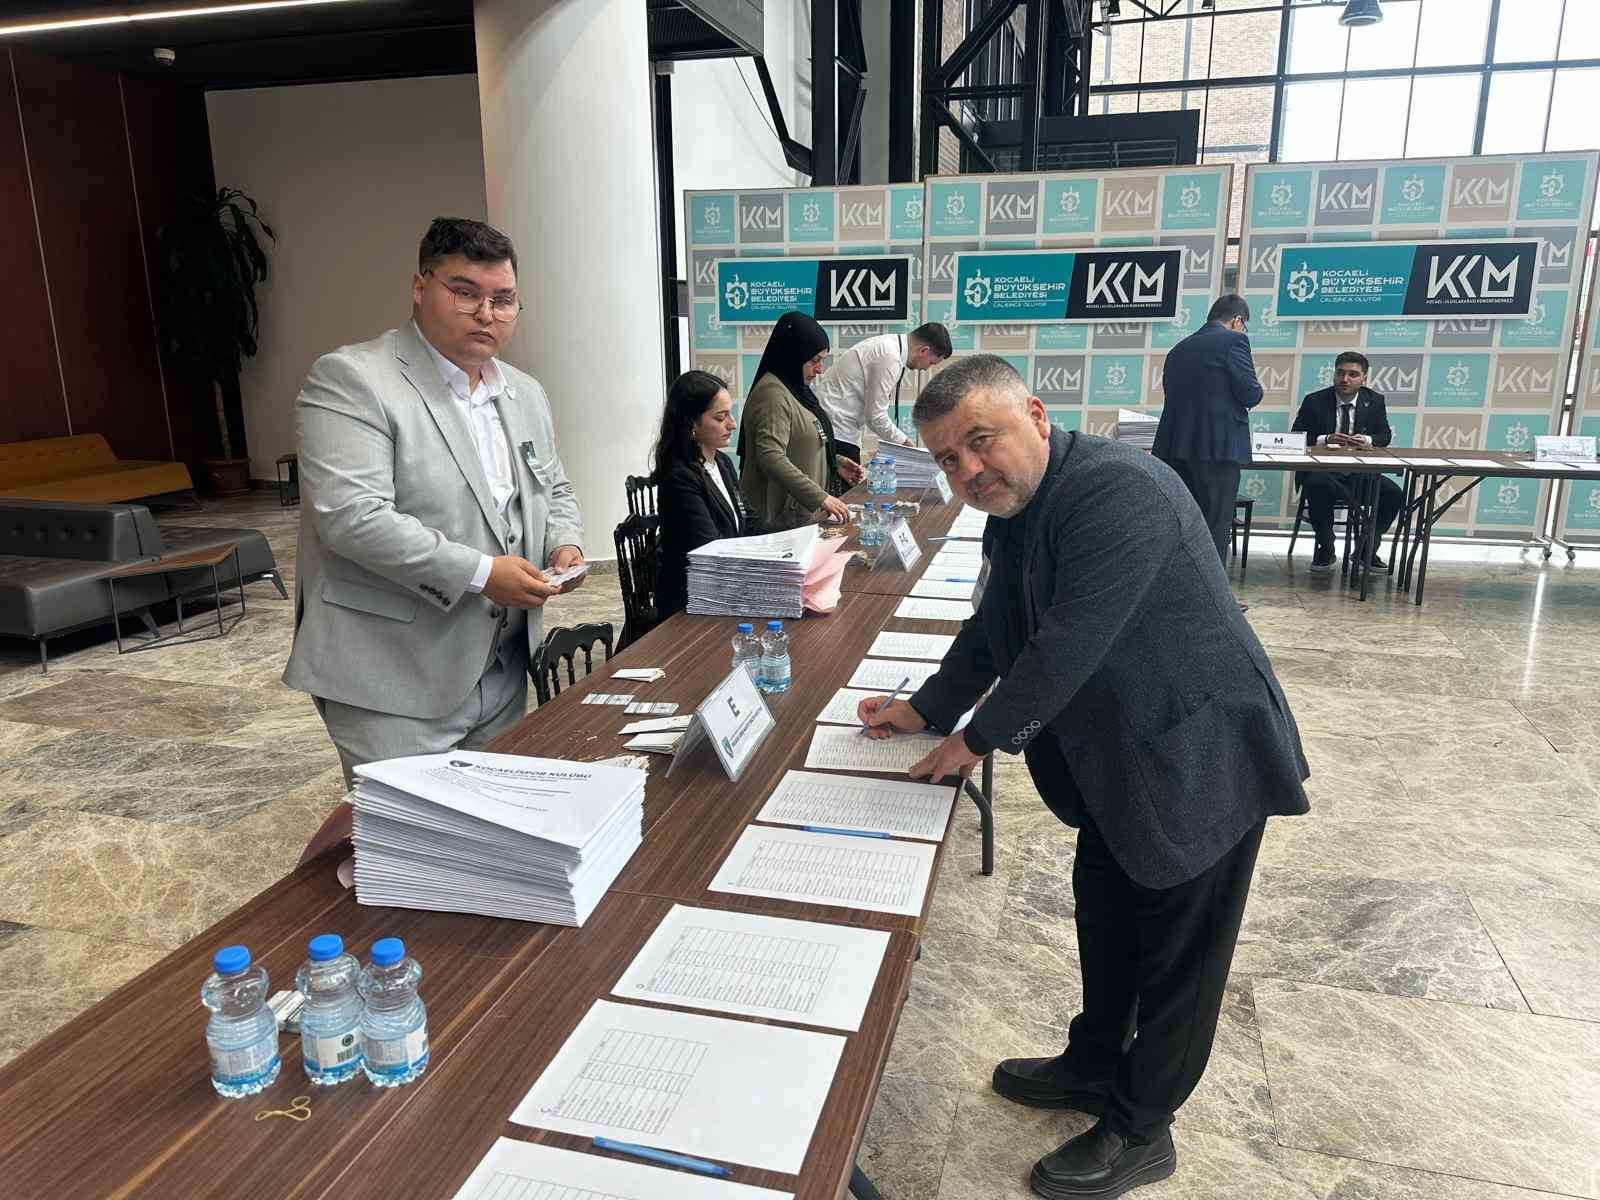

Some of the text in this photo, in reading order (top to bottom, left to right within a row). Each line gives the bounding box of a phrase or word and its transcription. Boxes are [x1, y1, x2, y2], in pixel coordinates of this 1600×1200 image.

[1105, 188, 1154, 218] KKM
[1319, 182, 1374, 210] KKM
[1453, 177, 1511, 208] KKM
[742, 205, 782, 229] KKM
[842, 202, 883, 227] KKM
[989, 193, 1035, 222] KKM
[829, 268, 897, 307] KKM
[1085, 261, 1168, 304] KKM
[1425, 254, 1520, 300] KKM
[1036, 367, 1081, 391] KKM
[1498, 366, 1553, 392] KKM
[726, 696, 741, 718] E
